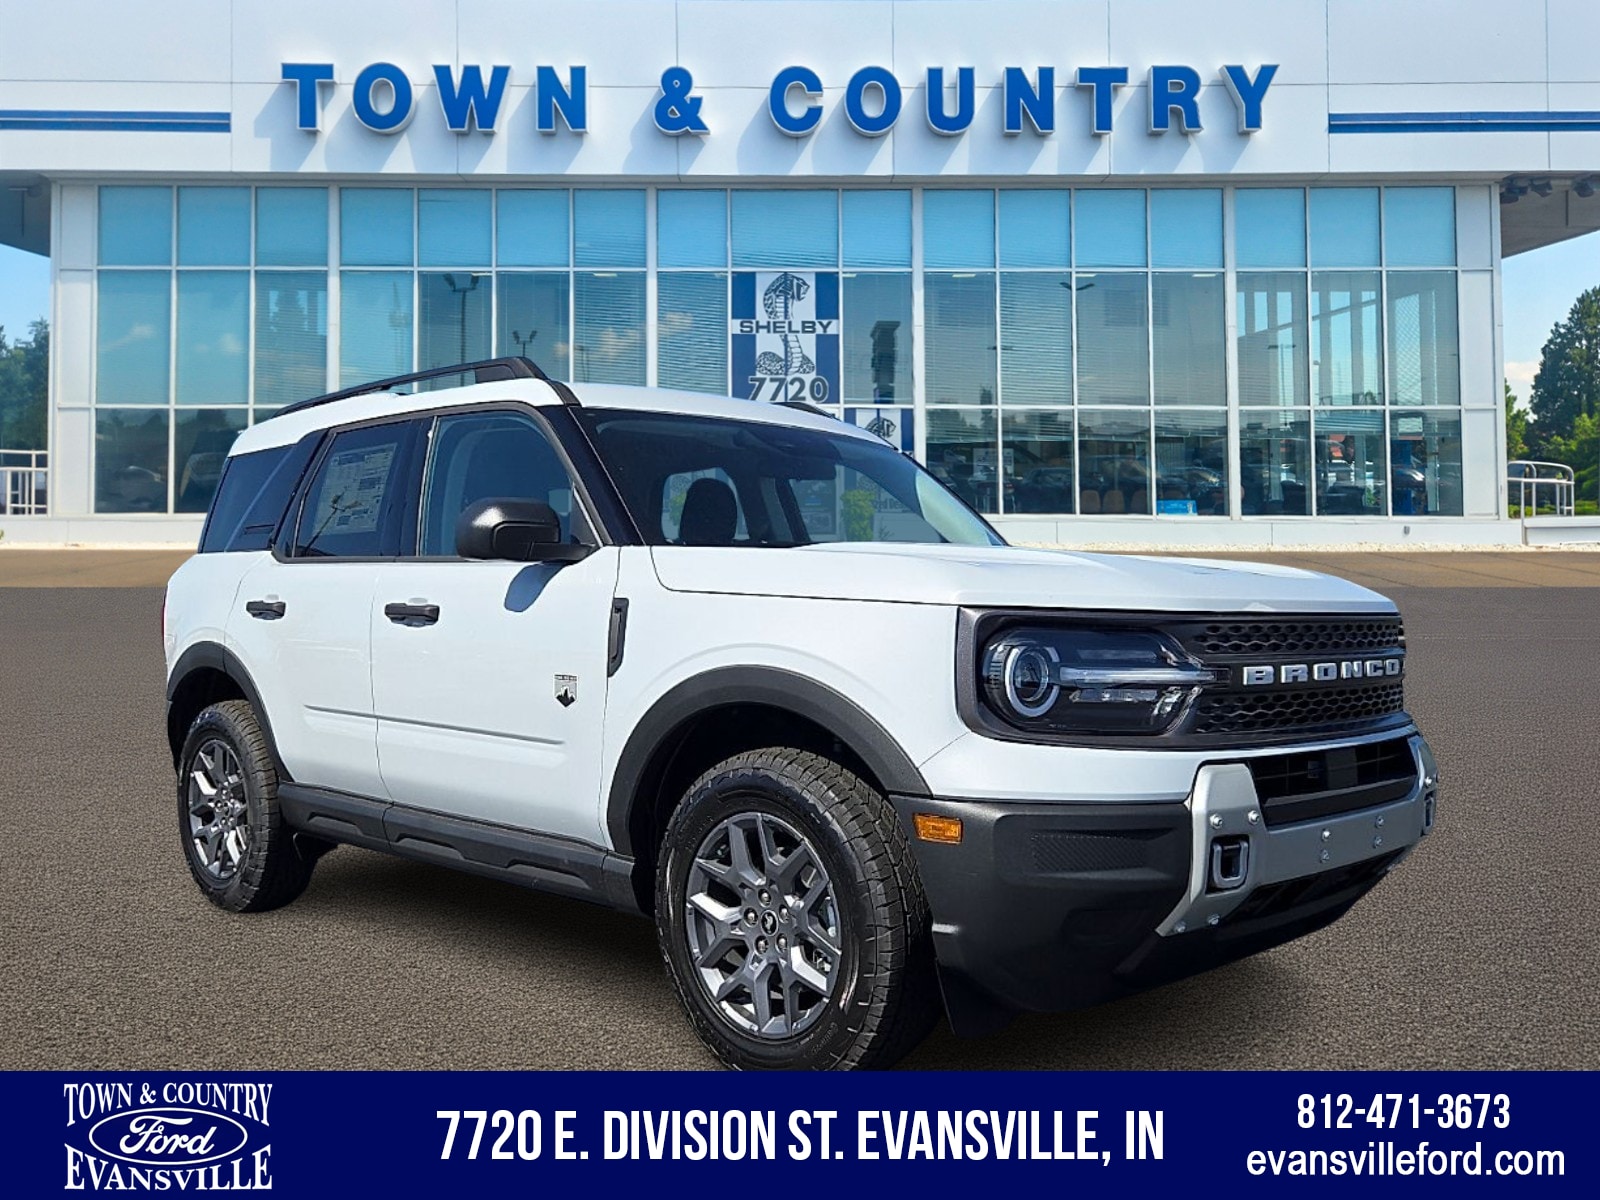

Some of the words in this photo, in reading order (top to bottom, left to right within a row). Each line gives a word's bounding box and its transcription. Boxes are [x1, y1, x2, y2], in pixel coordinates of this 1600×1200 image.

[281, 62, 588, 134] TOWN
[652, 66, 709, 135] &
[768, 64, 1279, 136] COUNTRY
[739, 320, 832, 334] SHELBY
[747, 376, 829, 403] 7720
[1243, 658, 1400, 686] BRONCO
